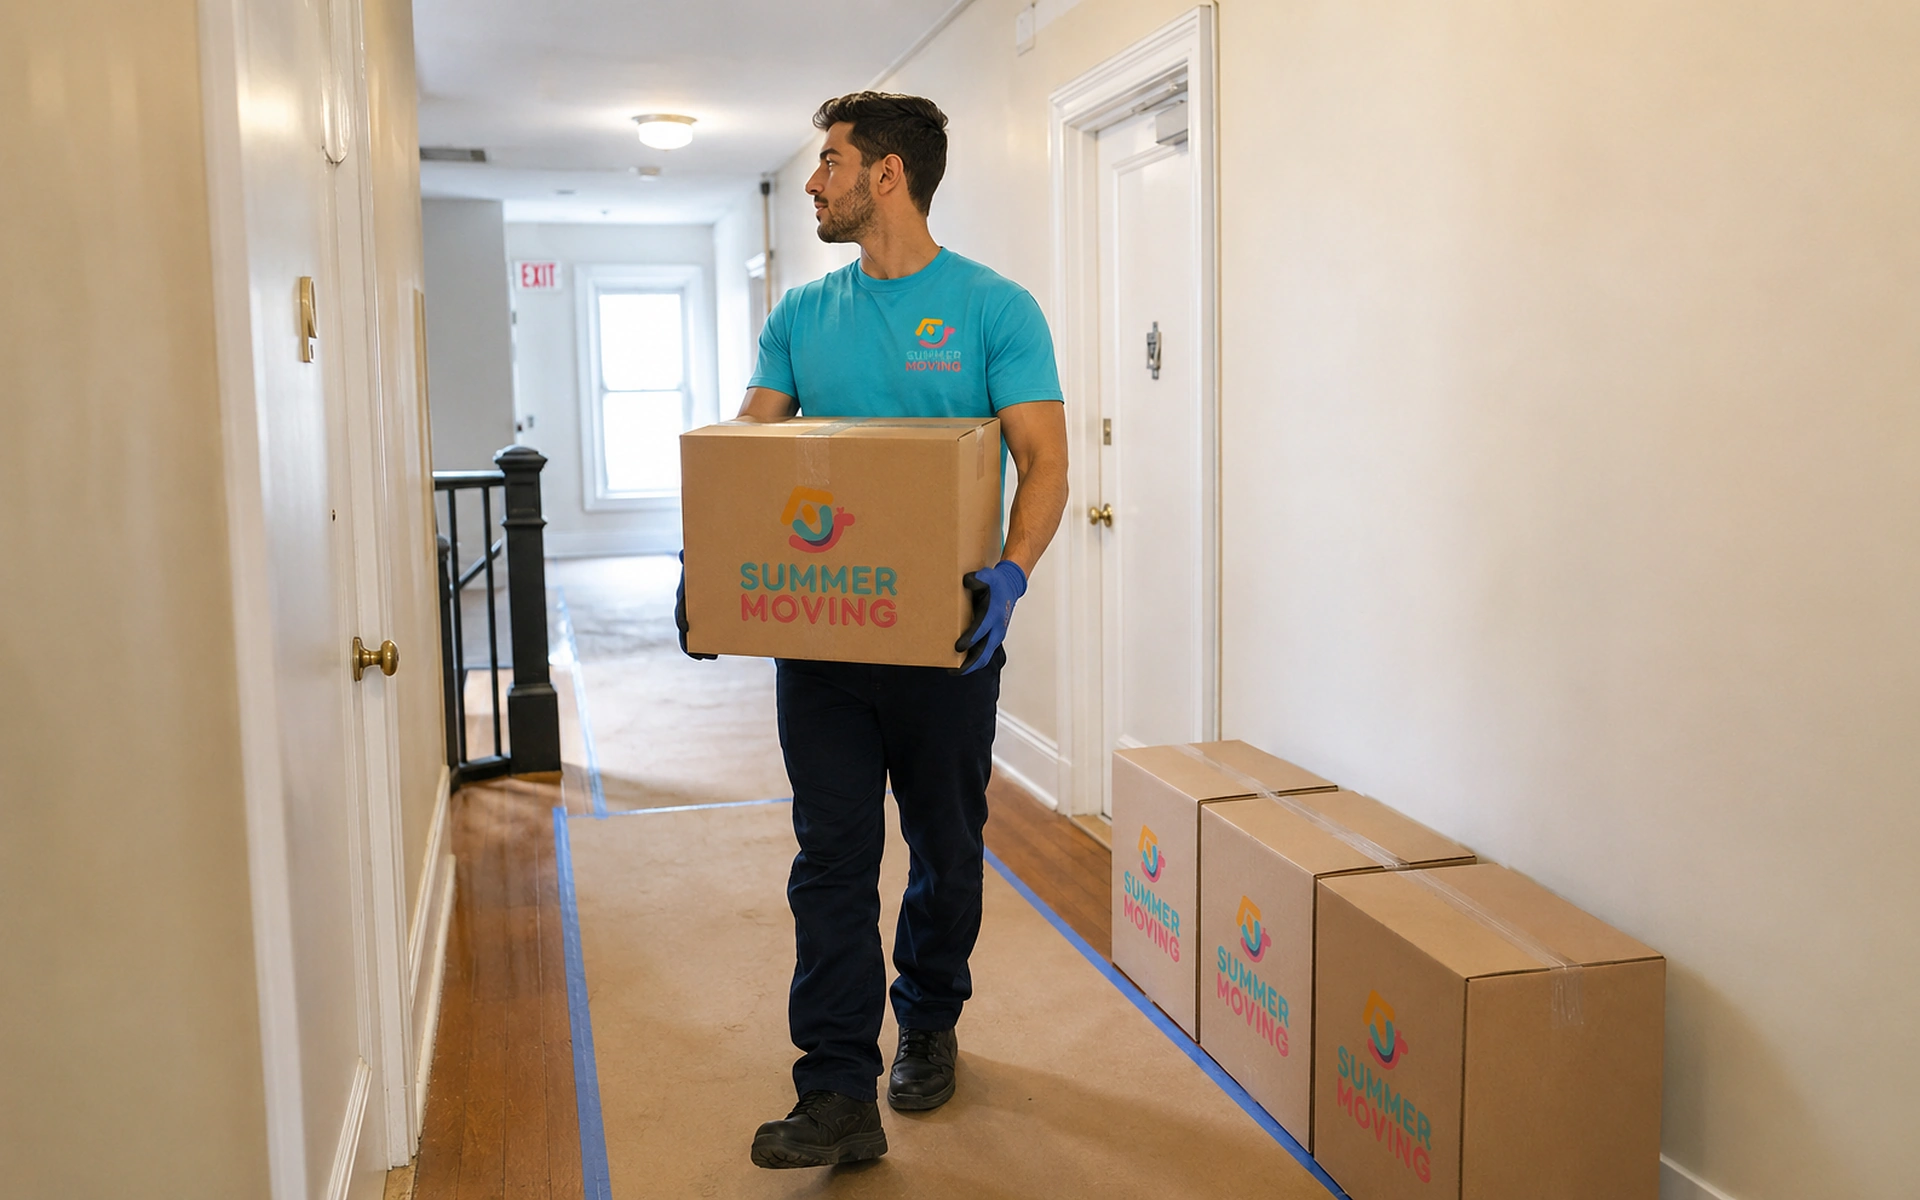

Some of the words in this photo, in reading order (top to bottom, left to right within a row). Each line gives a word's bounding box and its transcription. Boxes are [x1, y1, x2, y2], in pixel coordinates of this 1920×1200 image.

[521, 262, 556, 288] EXIT
[905, 361, 962, 373] MOVING
[740, 562, 898, 596] SUMMER
[740, 593, 898, 628] MOVING
[1124, 870, 1180, 938] SUMMER
[1124, 894, 1180, 963] MOVING
[1217, 945, 1289, 1029] SUMMER
[1217, 972, 1289, 1057] MOVING
[1337, 1045, 1431, 1151] SUMMER
[1337, 1076, 1431, 1184] MOVING
